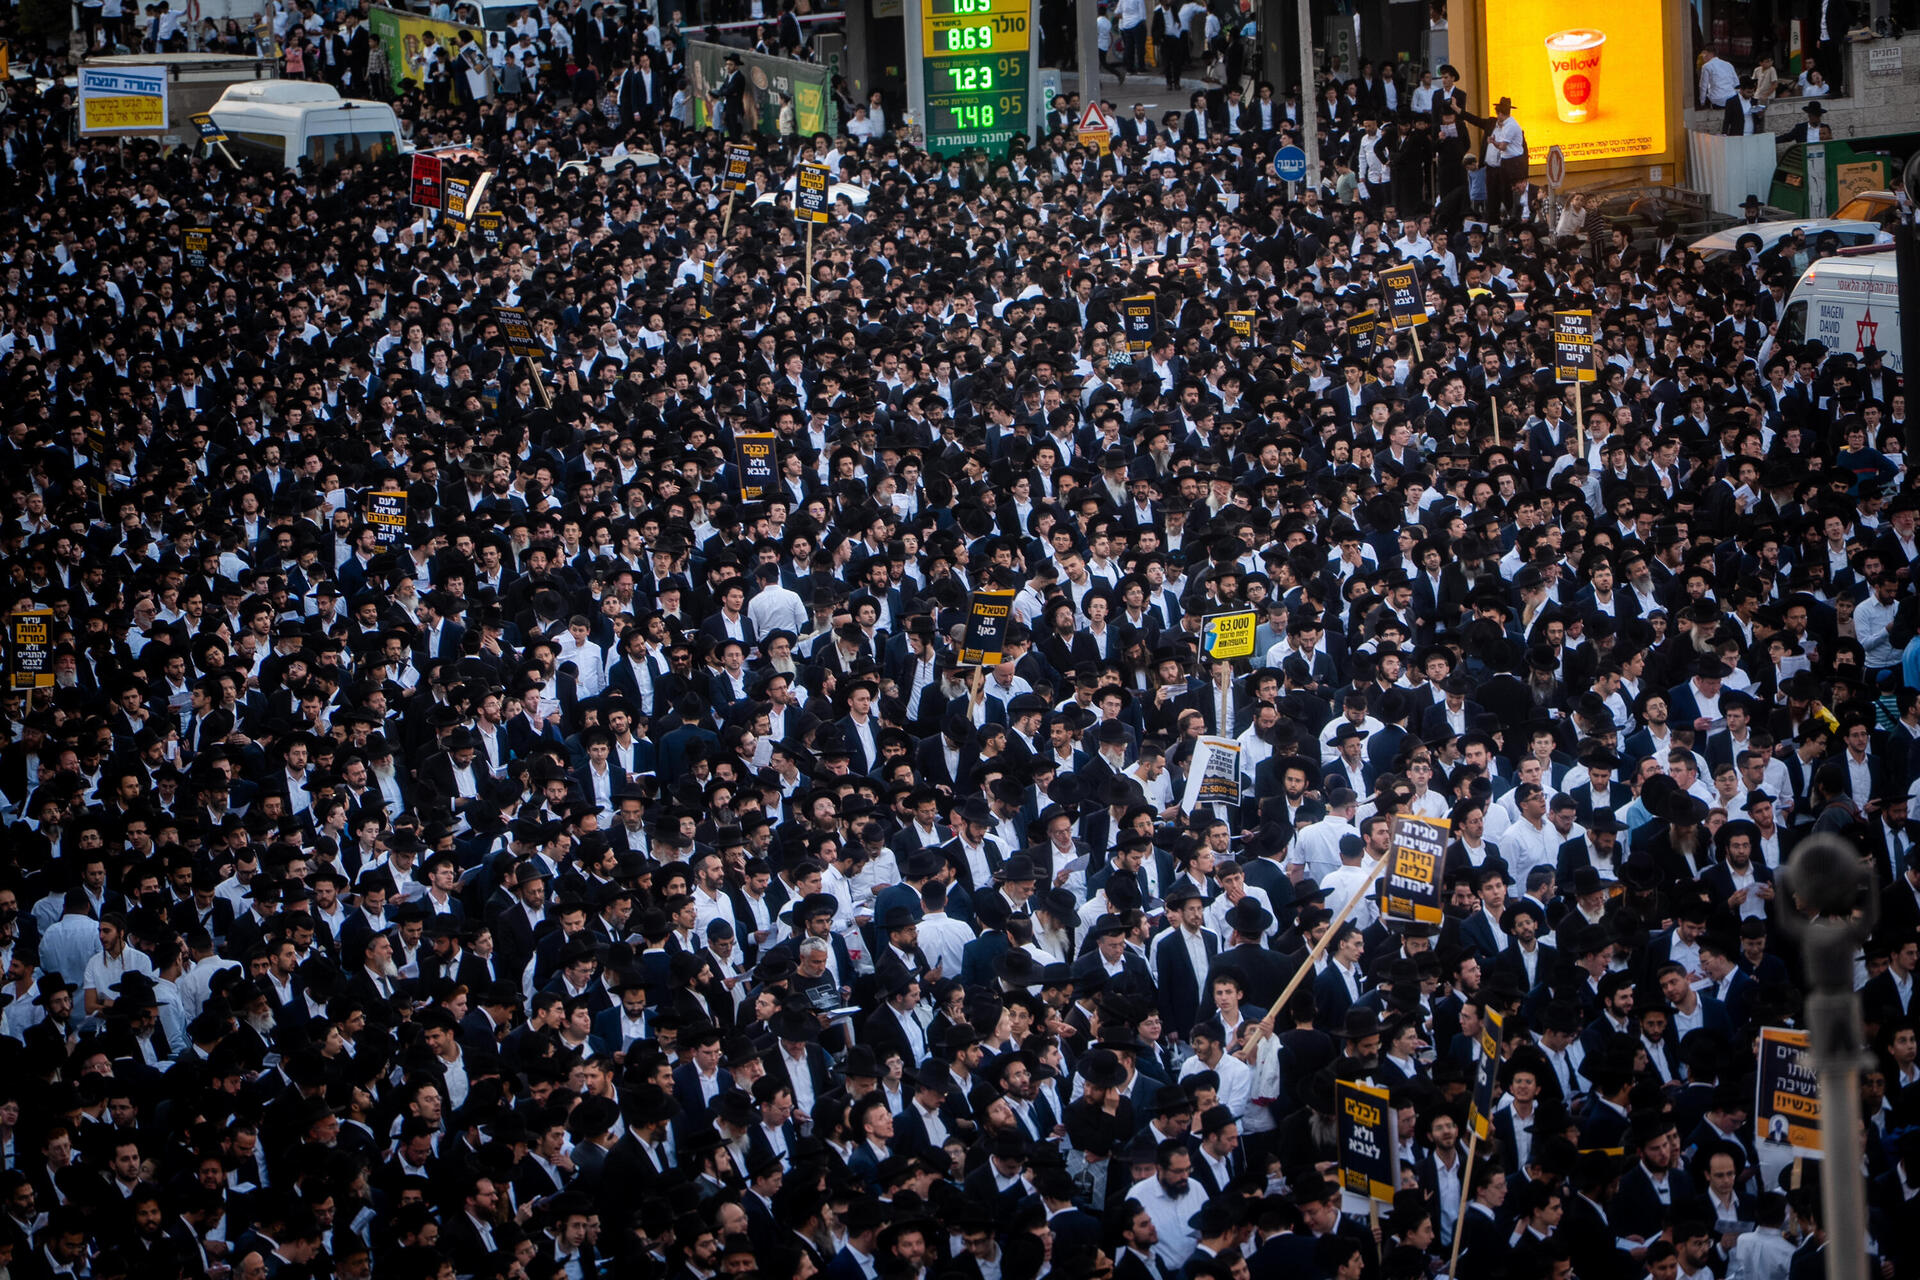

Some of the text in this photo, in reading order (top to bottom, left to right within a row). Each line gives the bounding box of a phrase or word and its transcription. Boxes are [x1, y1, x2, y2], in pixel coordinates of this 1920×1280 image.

[993, 15, 1026, 33] סולר
[948, 26, 992, 51] 8.69
[998, 58, 1021, 77] 95
[1552, 56, 1600, 72] yellow
[84, 74, 162, 93] התורה תנצח!
[948, 66, 993, 91] 7.23
[1000, 96, 1022, 115] 95
[950, 105, 994, 129] 7.48
[936, 132, 1012, 147] תחנה שומרת
[804, 173, 822, 183] למות
[801, 180, 823, 189] כחרדי
[803, 198, 820, 207] לצבא
[1395, 288, 1410, 298] ולא
[1885, 281, 1898, 294] רגון
[1393, 295, 1415, 306] לצבא
[1129, 307, 1149, 315] רוסיה
[1820, 304, 1845, 319] MAGEN
[1132, 321, 1149, 330] כאן!
[1564, 315, 1583, 326] לעם
[1560, 323, 1588, 335] ישראל
[1820, 320, 1840, 333] DAVID
[1556, 333, 1593, 344] בלי תורה
[1820, 335, 1840, 348] ADOM
[1558, 342, 1591, 354] אין זכות
[1566, 352, 1585, 363] קיום
[744, 445, 769, 453] לכלא
[750, 458, 766, 467] ולא
[746, 466, 771, 476] לצבא
[379, 496, 397, 506] לעם
[373, 504, 402, 515] ישראל
[368, 513, 405, 524] בלי תורה
[378, 523, 404, 534] אין זכ
[377, 532, 396, 543] קיום
[975, 604, 1006, 616] סטאלין
[22, 616, 41, 625] עדיף
[982, 616, 996, 626] זה
[1220, 616, 1250, 632] 63,000
[20, 624, 43, 633] למות
[976, 624, 996, 637] כאן!
[18, 634, 46, 643] כחרדי
[25, 643, 39, 651] ולא
[17, 650, 47, 659] להתגייס
[22, 658, 43, 666] לצבא
[1402, 821, 1439, 841] סגירת
[1393, 833, 1444, 857] הישיבות
[1400, 849, 1433, 867] גזירת
[1400, 862, 1428, 879] כליה
[1390, 873, 1435, 896] ליהדות
[1353, 1124, 1374, 1144] ולא
[1348, 1138, 1381, 1160] לצבא
